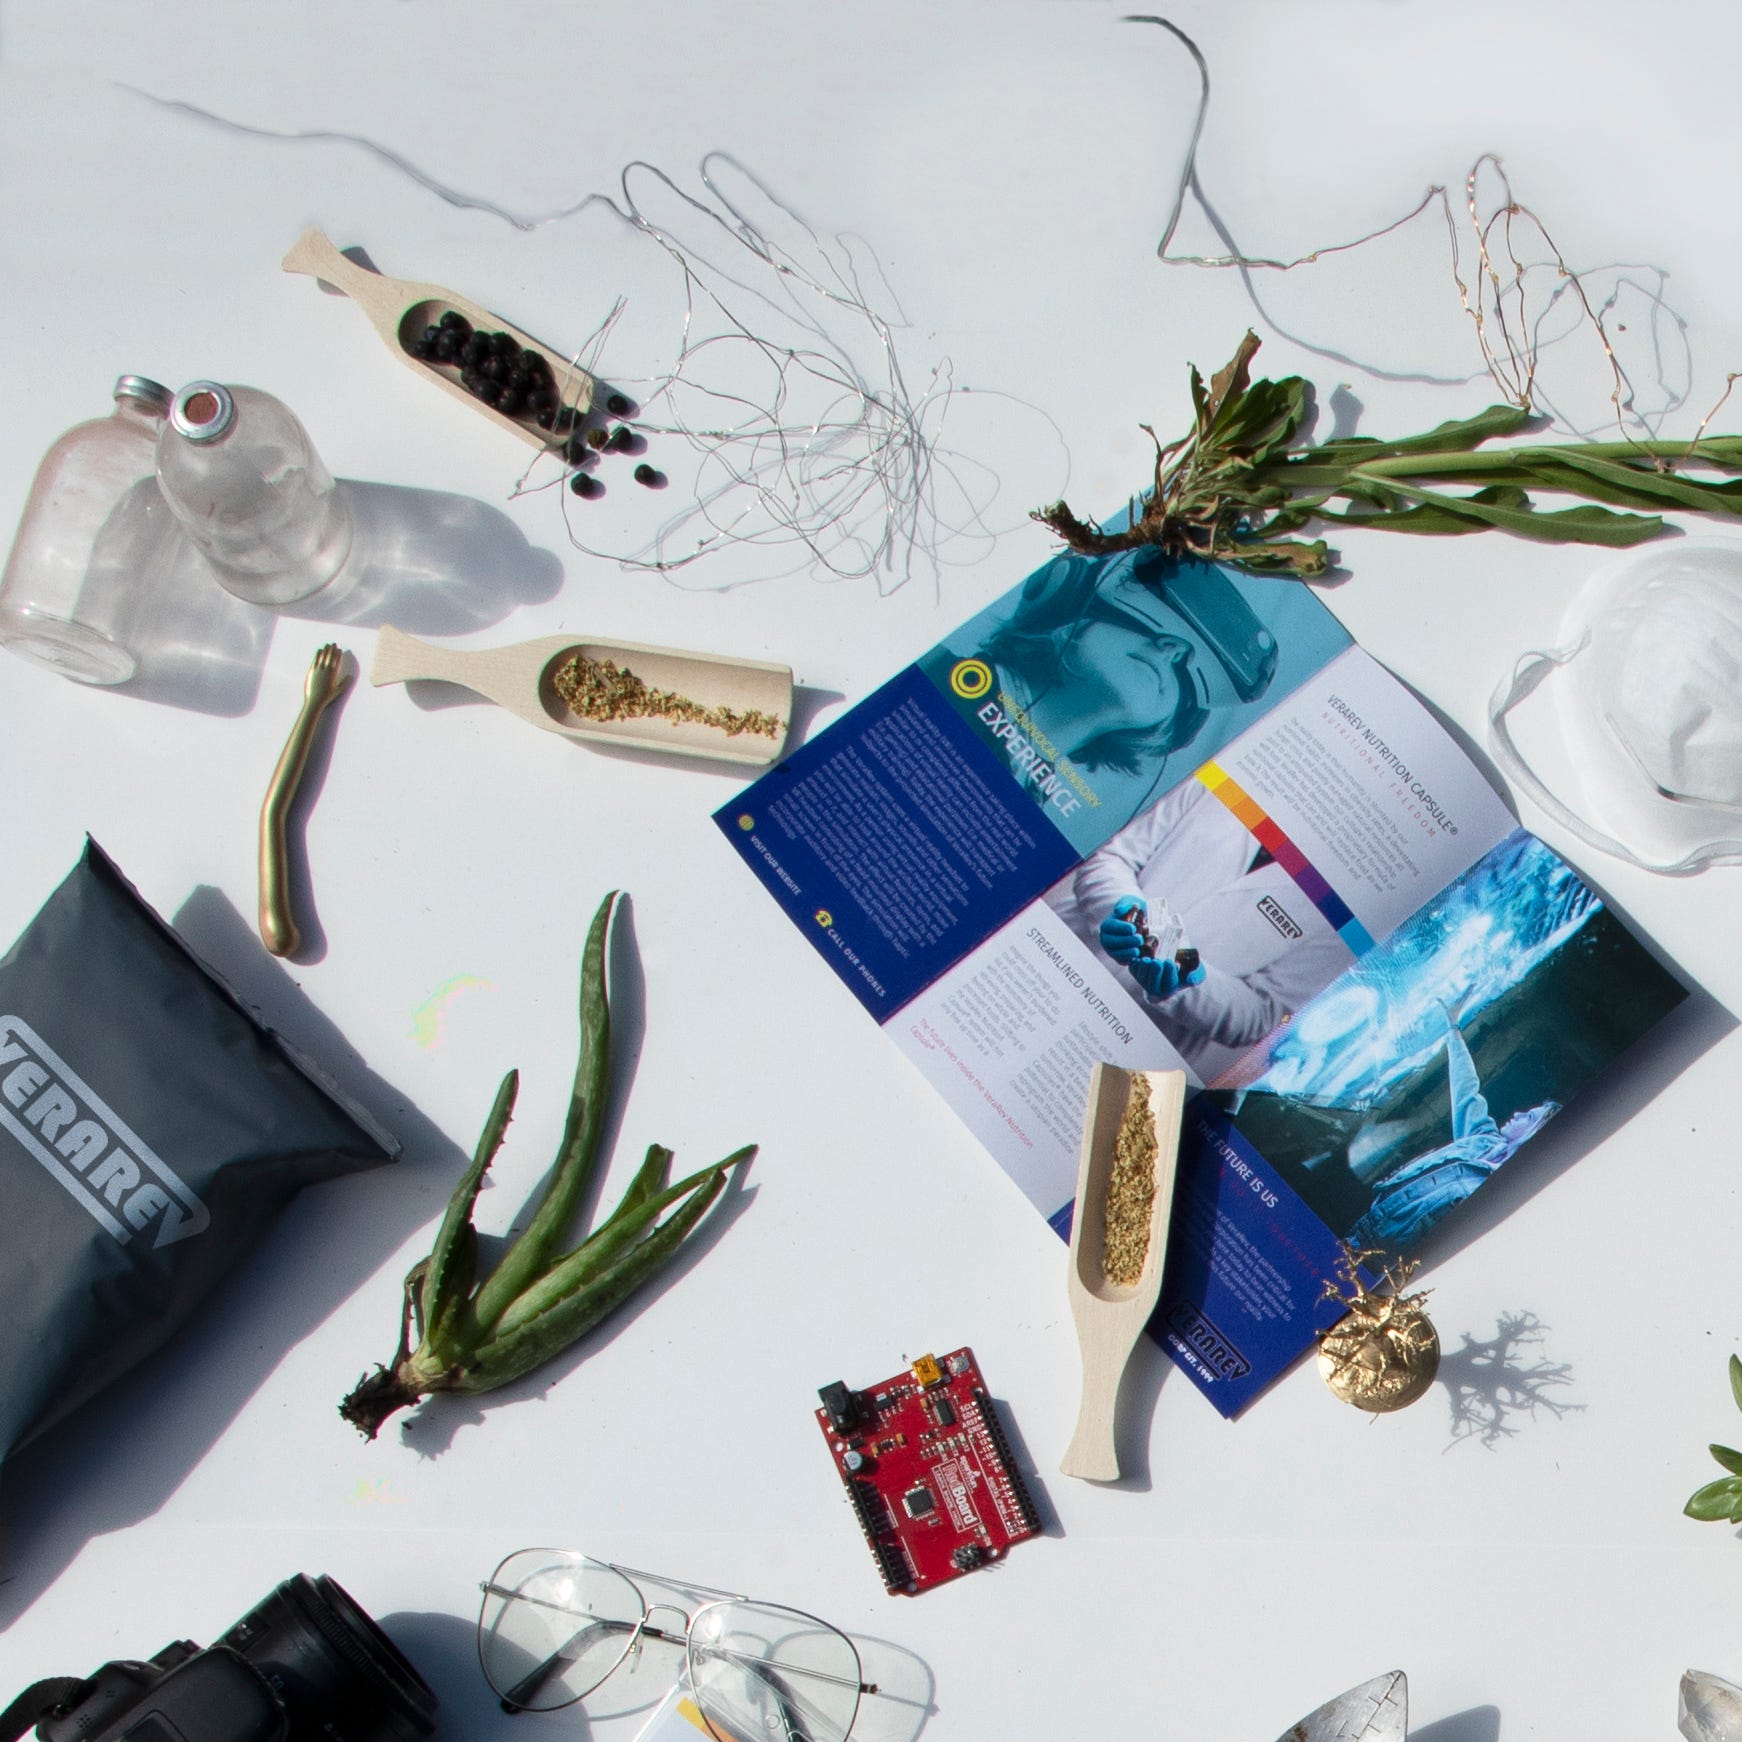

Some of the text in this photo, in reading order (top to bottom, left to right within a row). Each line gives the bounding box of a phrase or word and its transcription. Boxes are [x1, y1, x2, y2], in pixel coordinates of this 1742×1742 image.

[974, 700, 1083, 819] EXPERIENCE
[1325, 692, 1365, 733] VERAREV
[1359, 727, 1414, 785] NUTRITION
[1385, 780, 1440, 838] FREEDOM
[748, 834, 802, 896] VISIT OUR WEBSITE
[1259, 897, 1300, 941] VERAREV
[825, 927, 888, 998] CALL OUR PHONES
[1025, 926, 1085, 990] STREAMLINED
[1078, 986, 1134, 1046] NUTRITION
[970, 1078, 986, 1094] the
[1212, 1138, 1253, 1182] FUTURE
[1247, 1176, 1264, 1193] IS
[1258, 1188, 1279, 1209] US
